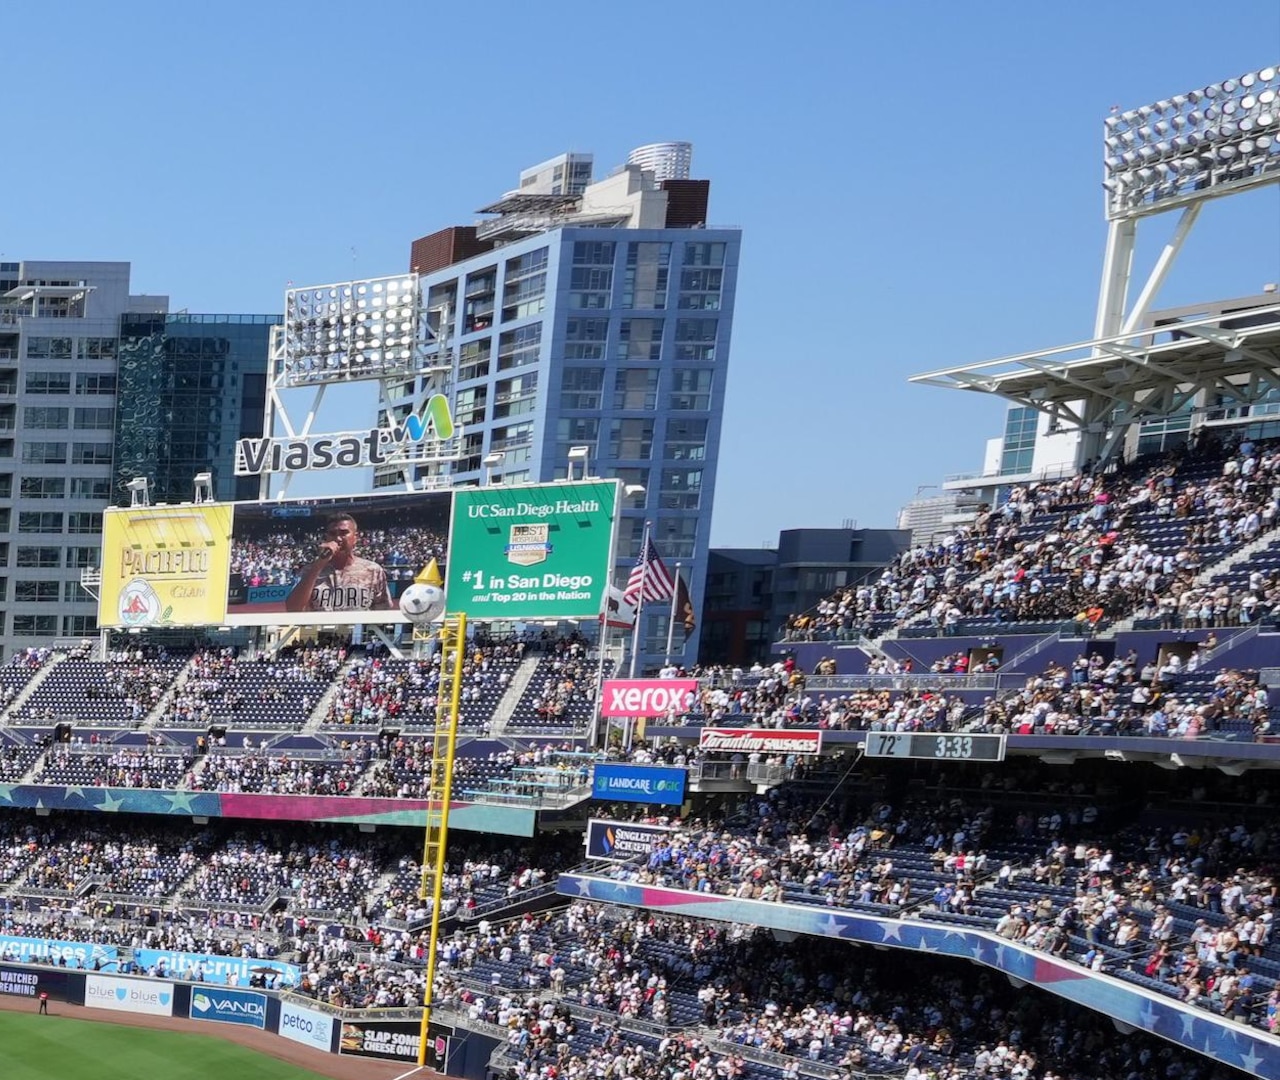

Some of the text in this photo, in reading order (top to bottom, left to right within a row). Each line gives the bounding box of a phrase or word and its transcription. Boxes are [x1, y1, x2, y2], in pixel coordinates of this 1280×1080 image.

[243, 430, 386, 473] Viasat
[468, 500, 599, 518] UC San Diego Health
[462, 570, 592, 590] #1 in San Diego
[250, 588, 286, 600] petco
[472, 591, 591, 603] and Top 20 in the Nation
[610, 688, 684, 711] xerox
[764, 738, 817, 751] SAUSAGES
[935, 737, 972, 758] 3:33
[609, 777, 651, 791] LANDCARE
[653, 780, 680, 792] LOGIC
[0, 971, 38, 985] WATCHED
[88, 986, 115, 997] blue
[131, 989, 158, 1002] blue
[212, 999, 264, 1017] VANDA
[283, 1013, 313, 1034] petco
[365, 1030, 421, 1046] SLAP SOME
[364, 1042, 396, 1054] CHEESE
[397, 1045, 409, 1056] ON
